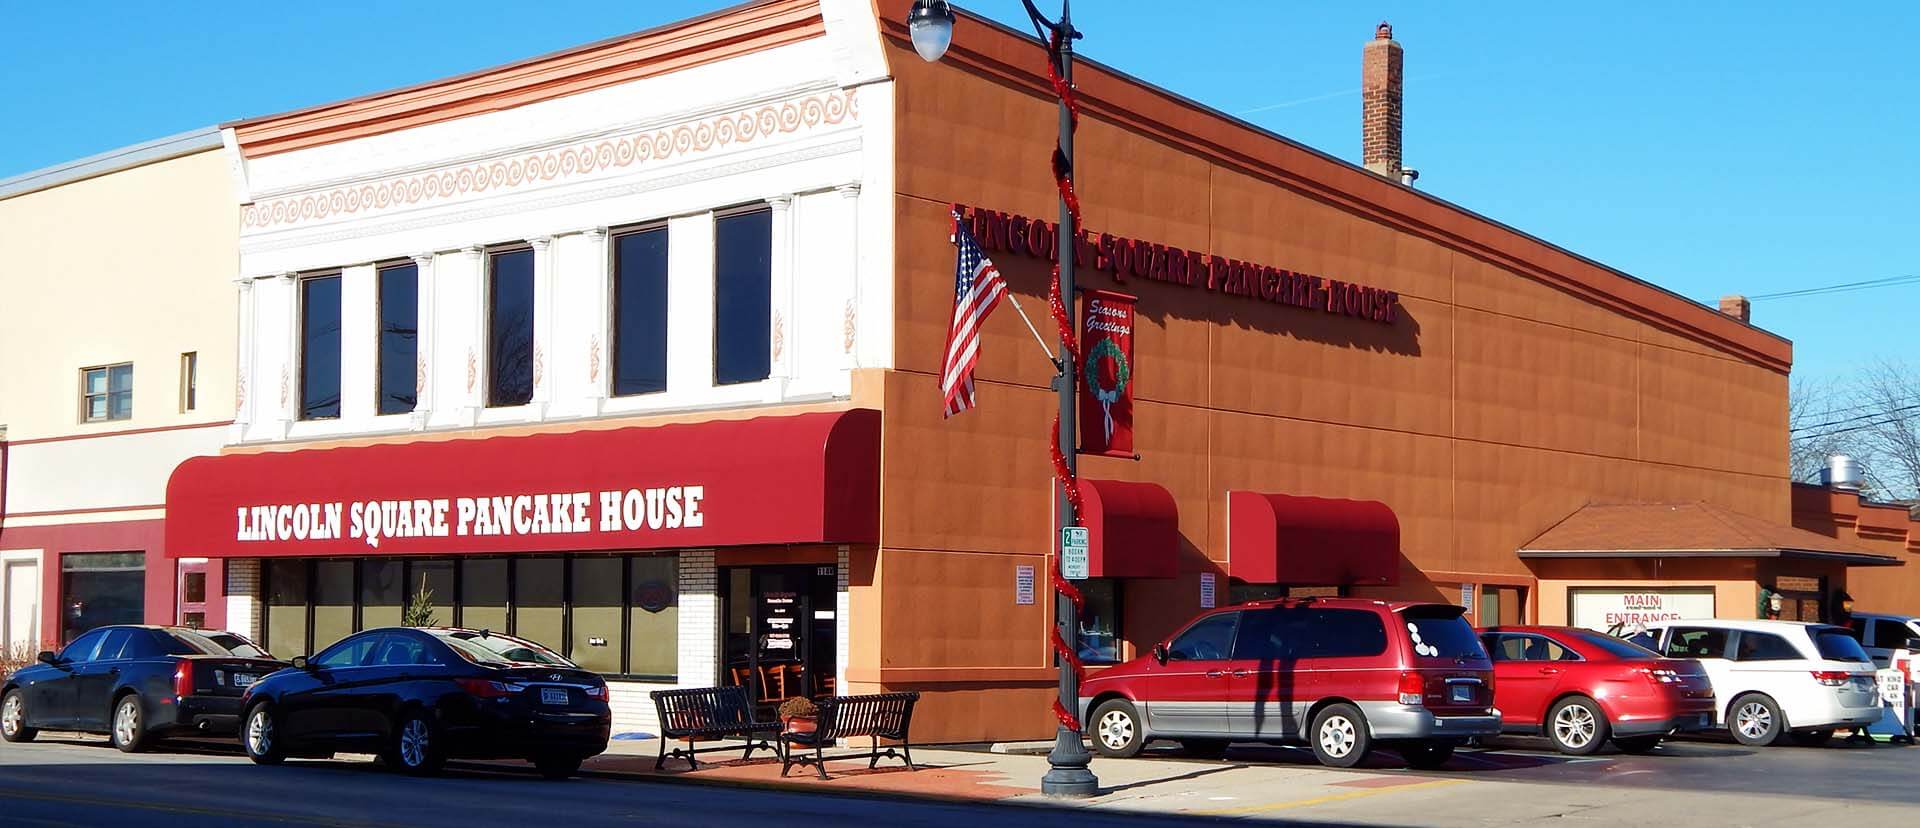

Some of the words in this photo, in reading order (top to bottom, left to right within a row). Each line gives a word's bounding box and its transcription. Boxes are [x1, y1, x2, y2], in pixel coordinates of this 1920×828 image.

[1095, 232, 1202, 285] SQUARE
[1204, 254, 1323, 309] PANCAKE
[1325, 279, 1399, 323] HOUSE
[1089, 299, 1127, 319] Seasons
[1086, 315, 1130, 337] Greetings
[237, 503, 343, 541] LINCOLN
[350, 499, 449, 548] SQUARE
[456, 492, 591, 536] PANCAKE
[600, 486, 704, 531] HOUSE
[1065, 531, 1070, 544] 2
[1623, 595, 1659, 606] MAIN
[1606, 613, 1679, 624] ENTRANCE
